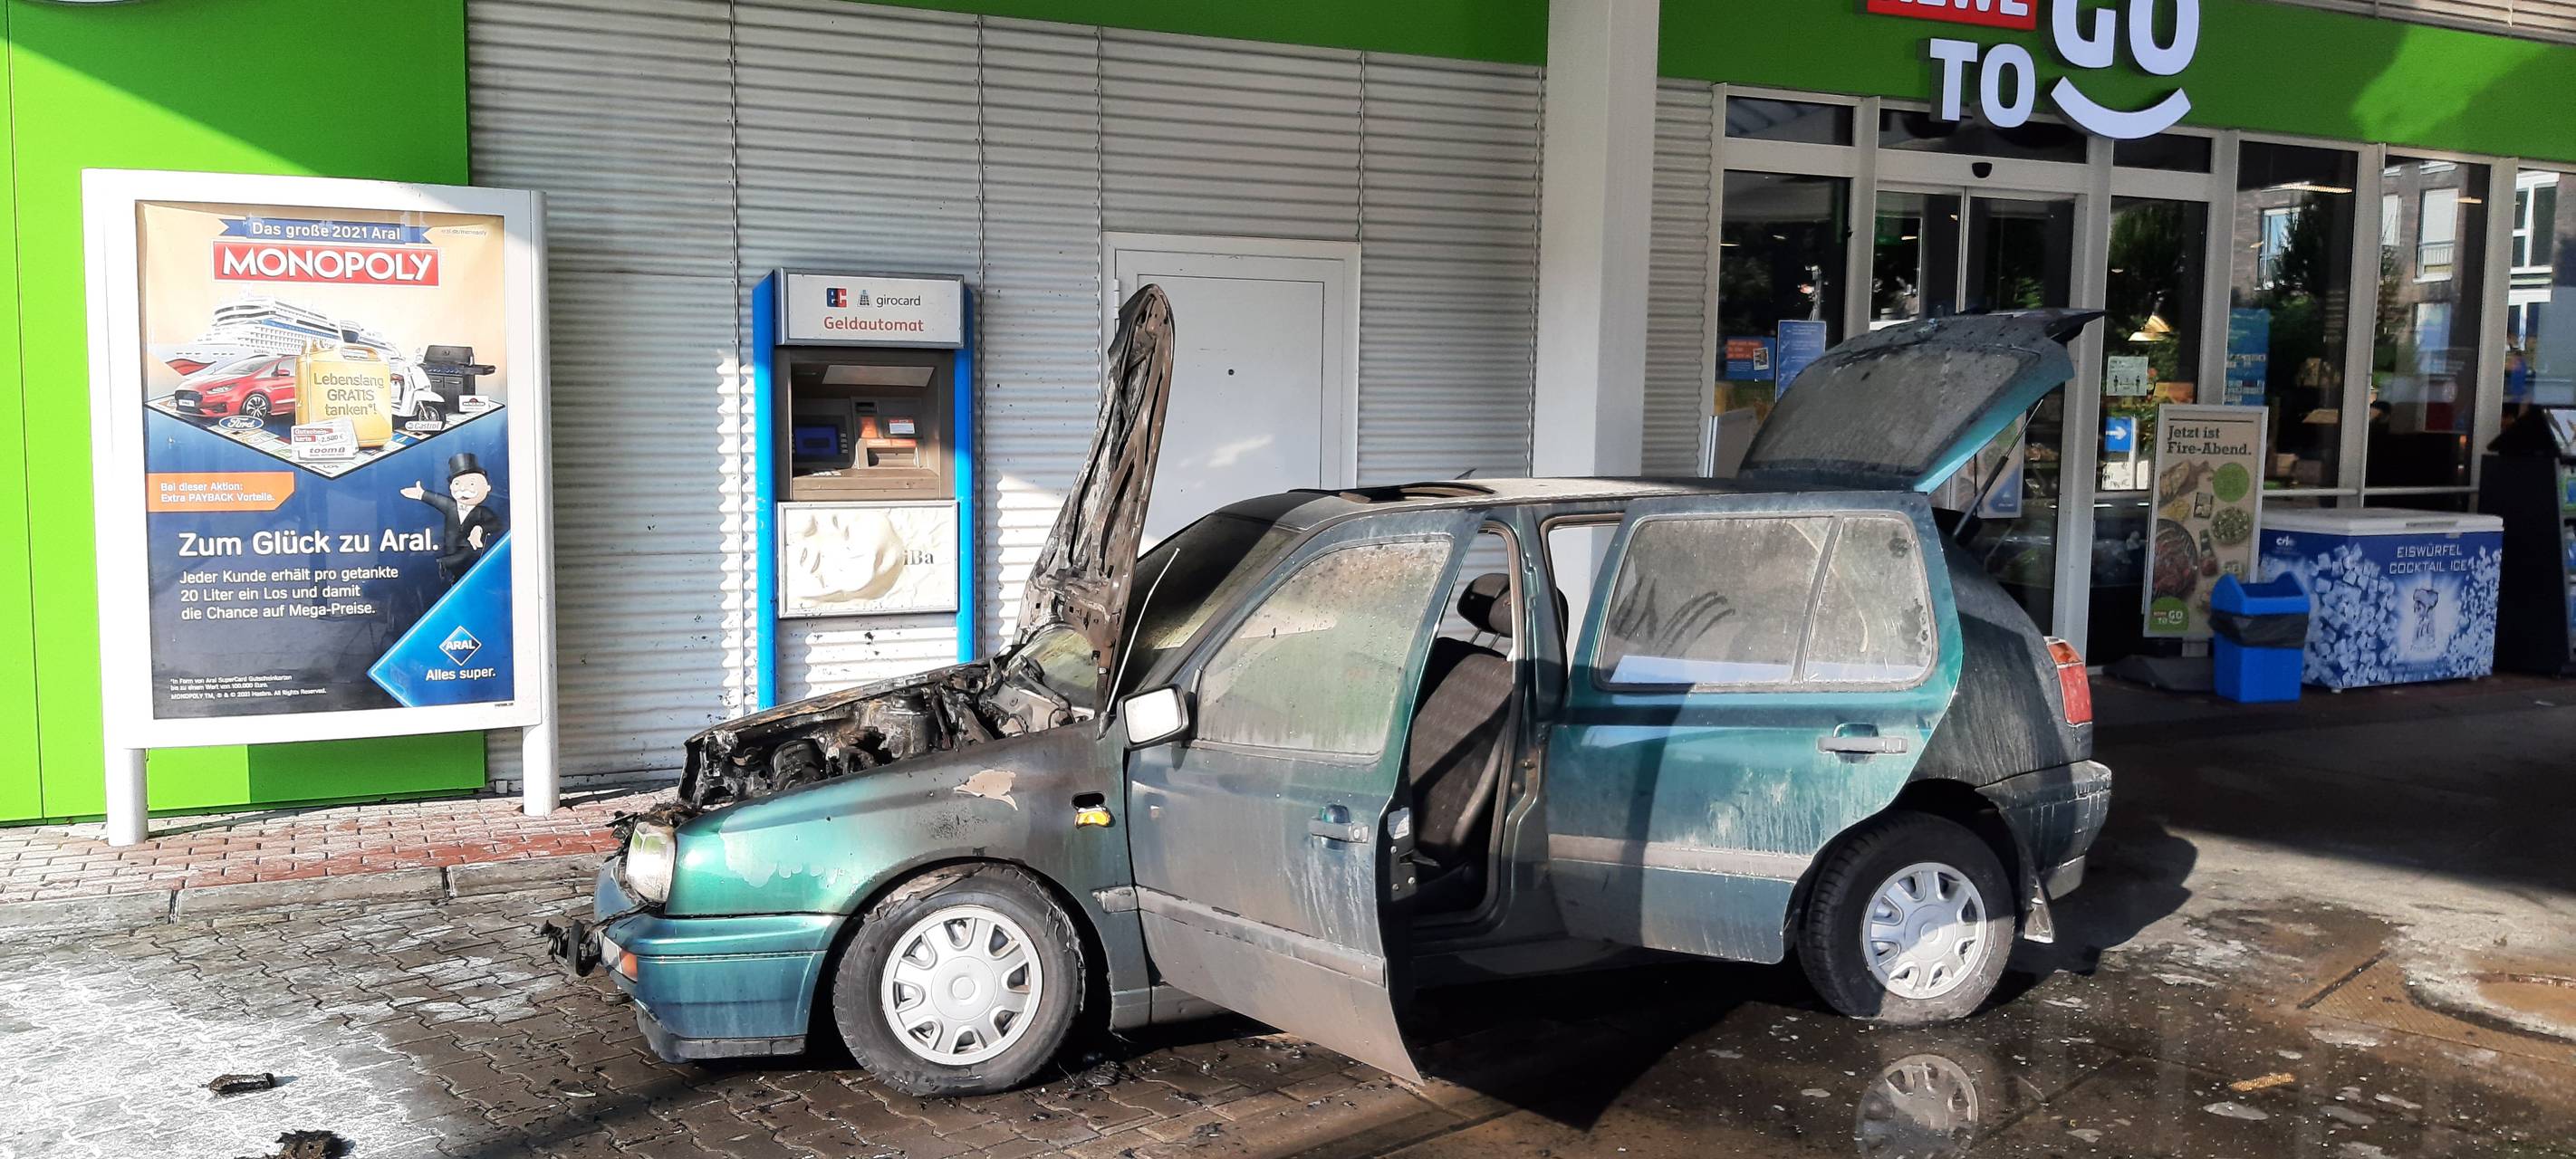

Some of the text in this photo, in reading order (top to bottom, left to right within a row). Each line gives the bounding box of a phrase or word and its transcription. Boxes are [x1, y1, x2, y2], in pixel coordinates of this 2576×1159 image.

[1930, 0, 2200, 128] TO GO
[253, 222, 400, 240] Das große 2021 Aral
[223, 245, 433, 282] MONOPOLY
[876, 294, 921, 308] girocard
[823, 316, 924, 331] Geldautomat
[313, 372, 384, 388] Lebenslang
[327, 389, 375, 401] GRATIS
[414, 422, 440, 431] Castrol
[2167, 426, 2220, 441] Jetzt ist
[2166, 442, 2252, 455] Fire-Abend.
[160, 482, 244, 492] Bei dieser Aktion:
[161, 492, 275, 503] Extra PAYBACK Vorteile.
[178, 528, 438, 557] Zum Glück zu Aral.
[903, 549, 935, 566] iBa
[2397, 543, 2463, 558] EISWÜRFEL
[2389, 560, 2468, 574] COCKTAIL ICE
[179, 566, 399, 584] Jeder Kunde erhält pro getankte
[180, 584, 361, 602] 20 Liter ein Los und damit
[181, 602, 376, 620] die Chance auf Mega-Preise.
[2168, 609, 2184, 621] GO
[446, 639, 476, 651] ARAL
[425, 667, 496, 682] Alles super.
